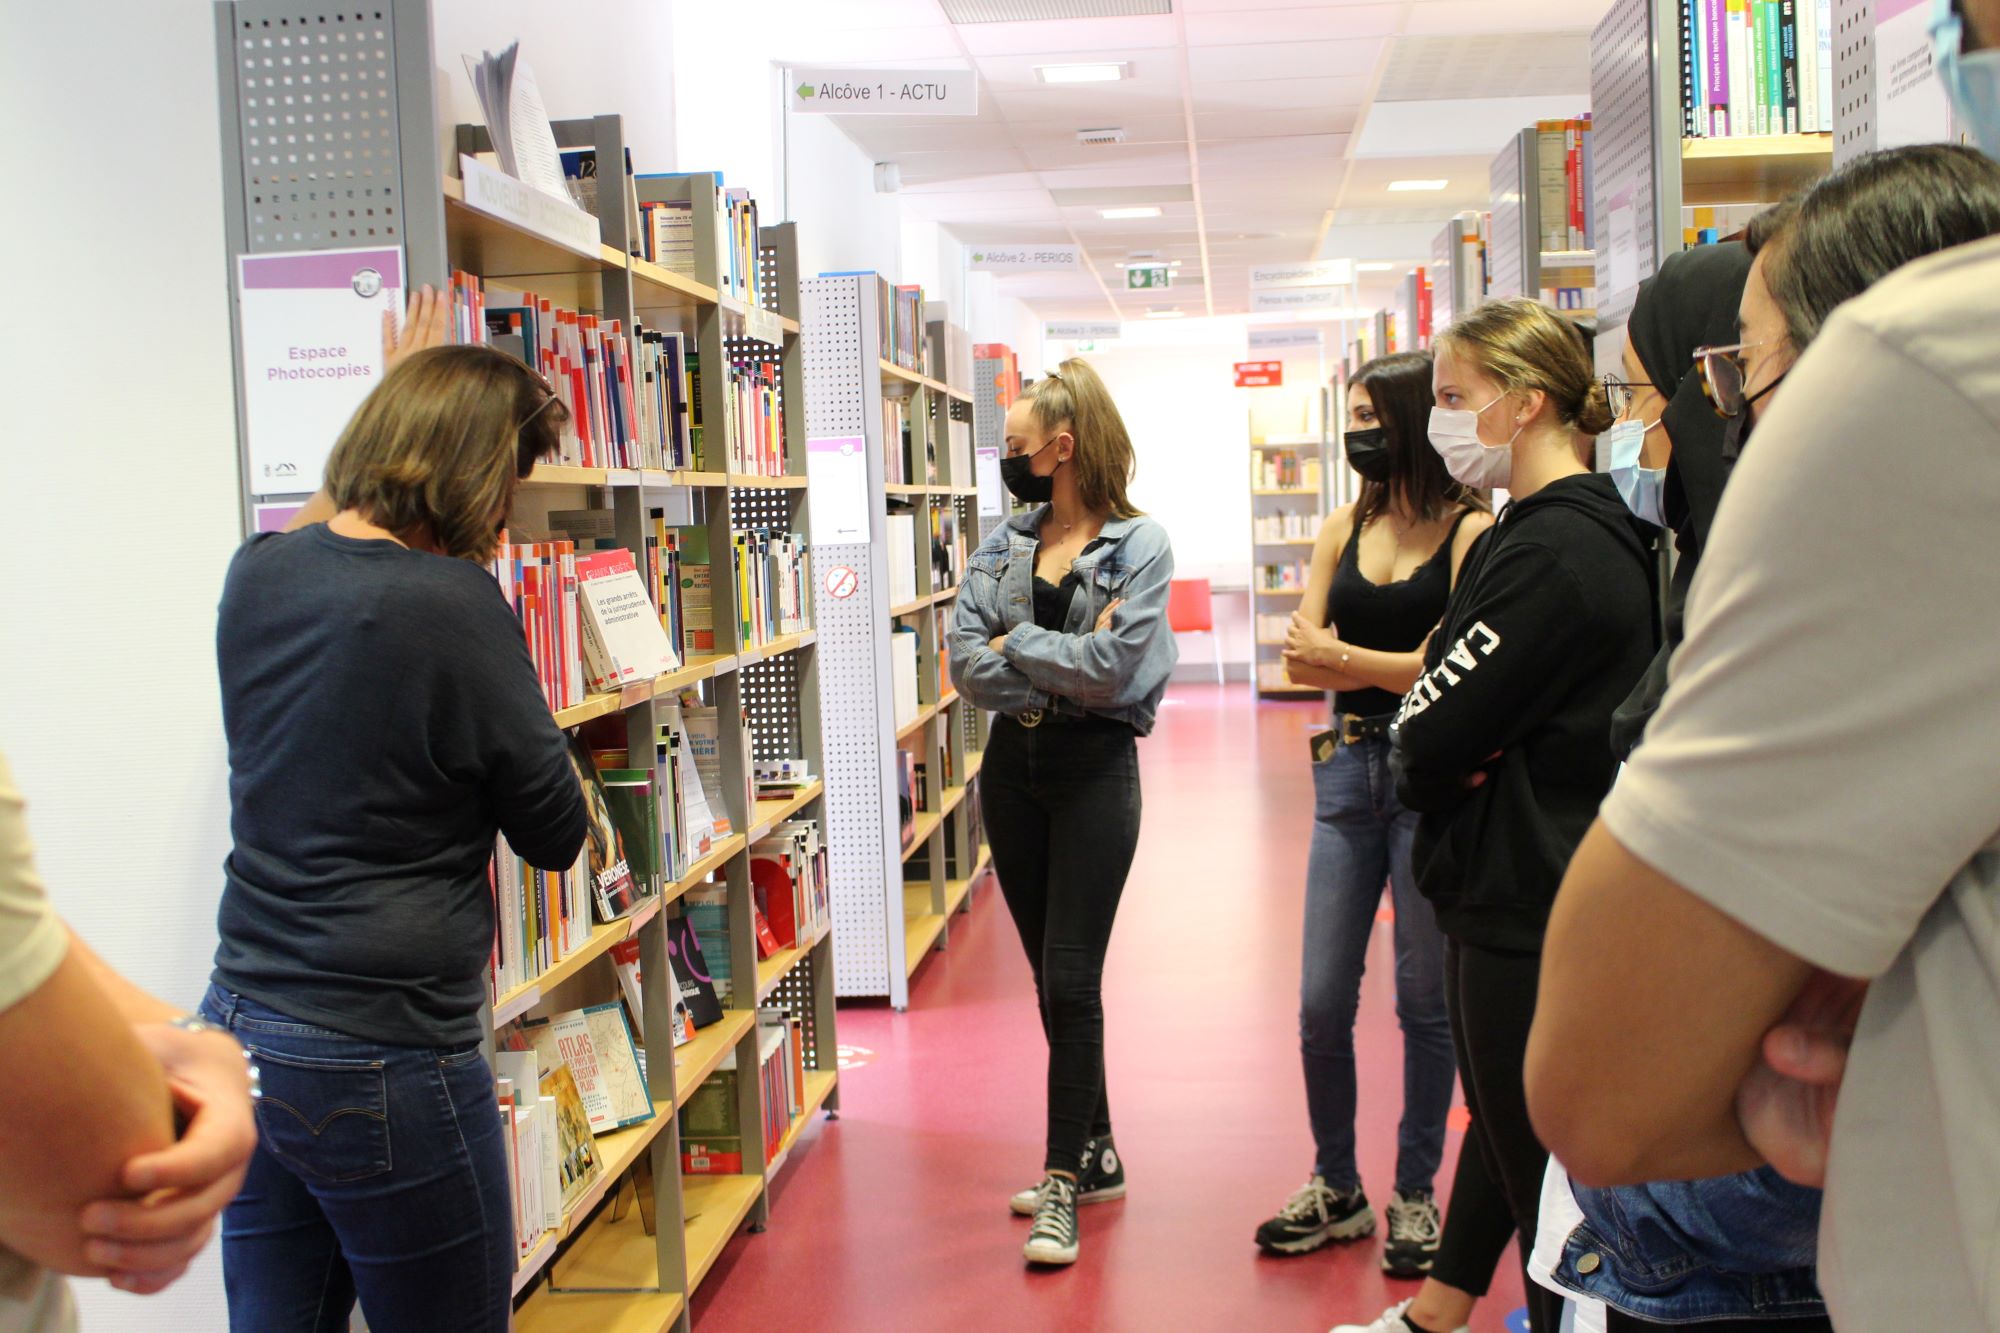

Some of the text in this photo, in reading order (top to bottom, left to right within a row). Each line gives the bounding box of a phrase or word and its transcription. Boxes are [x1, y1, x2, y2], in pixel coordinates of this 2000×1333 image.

[1712, 21, 1721, 52] technique
[1713, 53, 1719, 61] de
[1713, 62, 1721, 92] Principes
[819, 82, 871, 100] Alcôve
[877, 84, 884, 100] 1
[900, 83, 947, 101] ACTU
[986, 252, 1017, 264] Alcôve
[1019, 252, 1026, 263] 2
[288, 346, 348, 362] Espace
[267, 363, 371, 382] Photocopies
[597, 590, 639, 606] Les grands arrêts
[600, 608, 608, 616] de
[613, 598, 647, 615] jurisprudence
[604, 612, 640, 625] administrative
[596, 858, 631, 888] VÉRONÈSE
[558, 1033, 593, 1060] ATLAS
[572, 1064, 600, 1082] EXISTENT
[579, 1080, 596, 1094] PLUS
